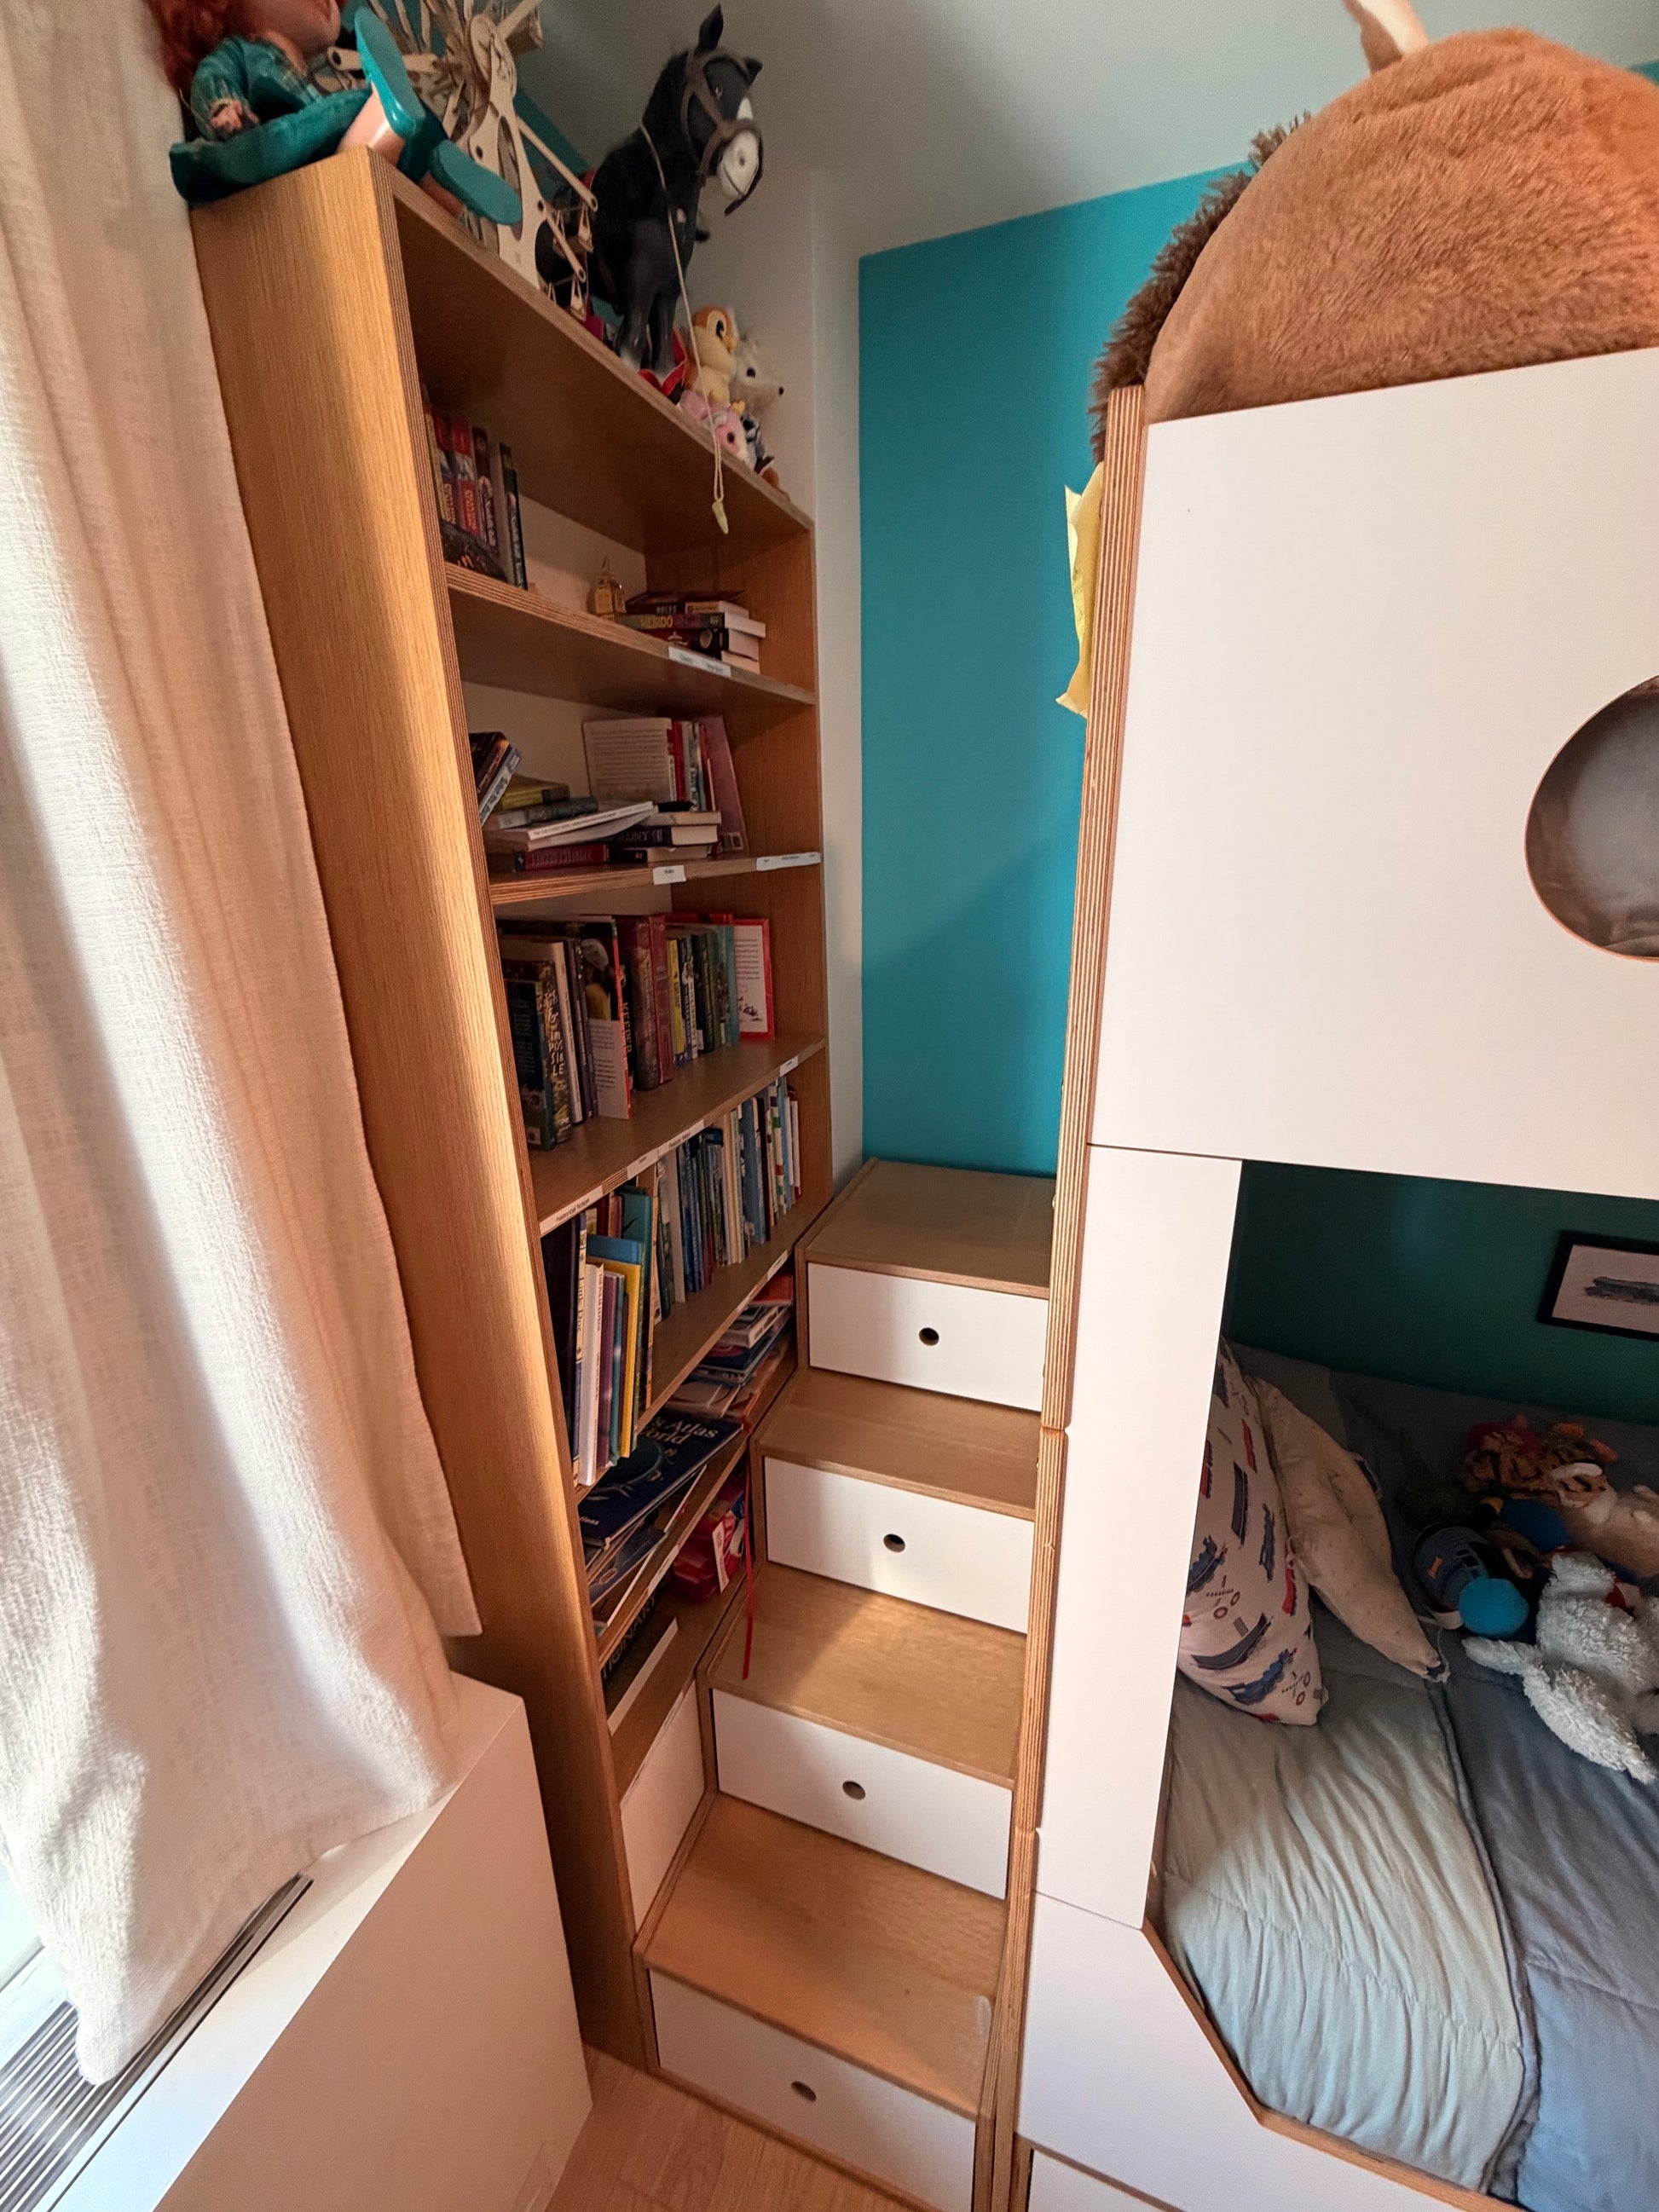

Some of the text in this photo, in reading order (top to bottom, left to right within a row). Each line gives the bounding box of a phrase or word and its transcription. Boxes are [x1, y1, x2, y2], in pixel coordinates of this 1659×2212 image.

[640, 614, 673, 629] WEIRDO
[621, 1002, 633, 1054] KEEPER
[663, 1419, 719, 1439] Atlas
